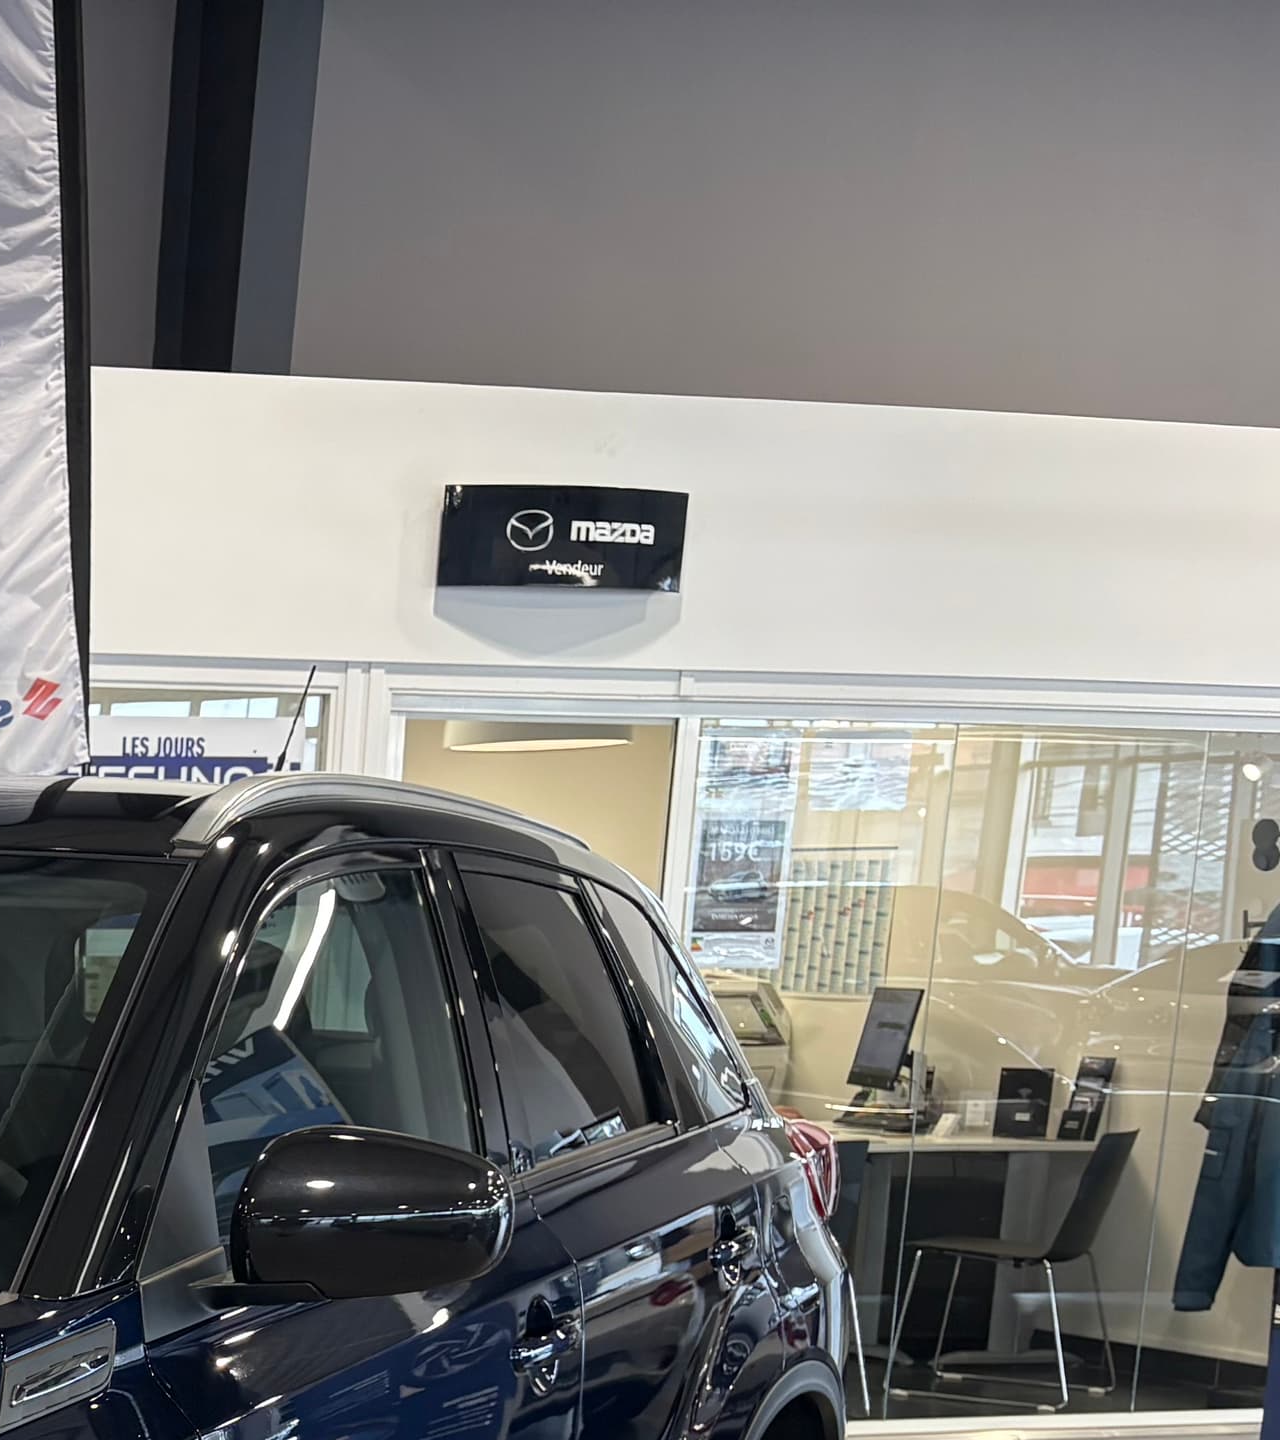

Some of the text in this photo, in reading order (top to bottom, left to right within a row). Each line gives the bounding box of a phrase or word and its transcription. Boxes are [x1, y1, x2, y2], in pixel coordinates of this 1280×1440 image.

[544, 559, 605, 577] Vendeur
[122, 736, 205, 758] LES JOURS
